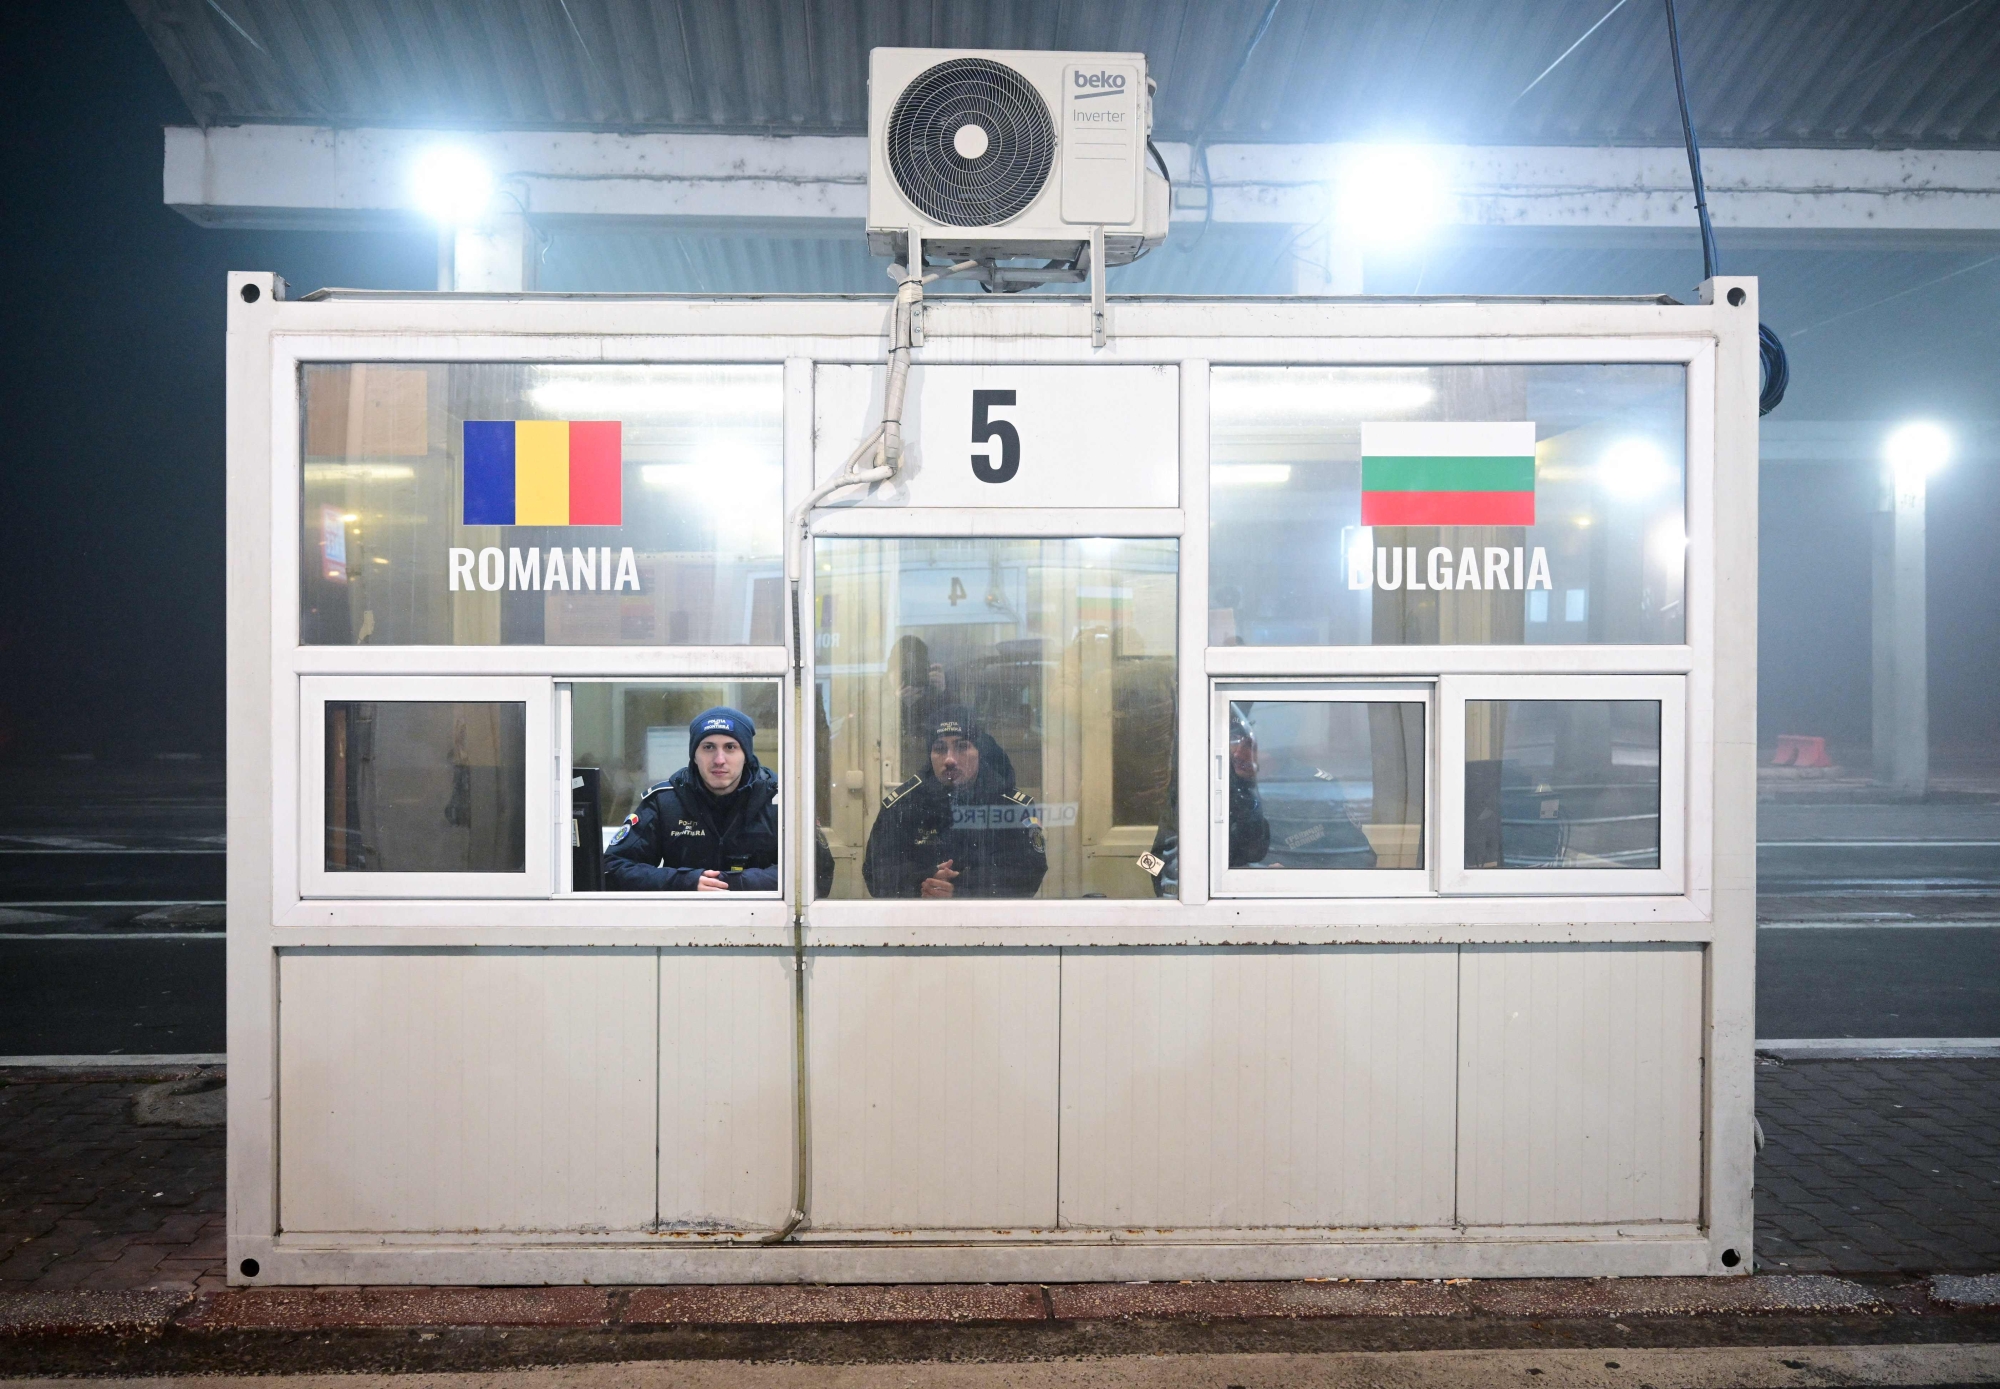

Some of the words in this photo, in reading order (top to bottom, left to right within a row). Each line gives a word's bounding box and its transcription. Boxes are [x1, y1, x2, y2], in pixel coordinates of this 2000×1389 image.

[1074, 70, 1126, 88] beko
[1073, 109, 1125, 122] Inverter
[970, 389, 1021, 484] 5
[448, 546, 641, 592] ROMANIA
[1347, 545, 1554, 591] BULGARIA
